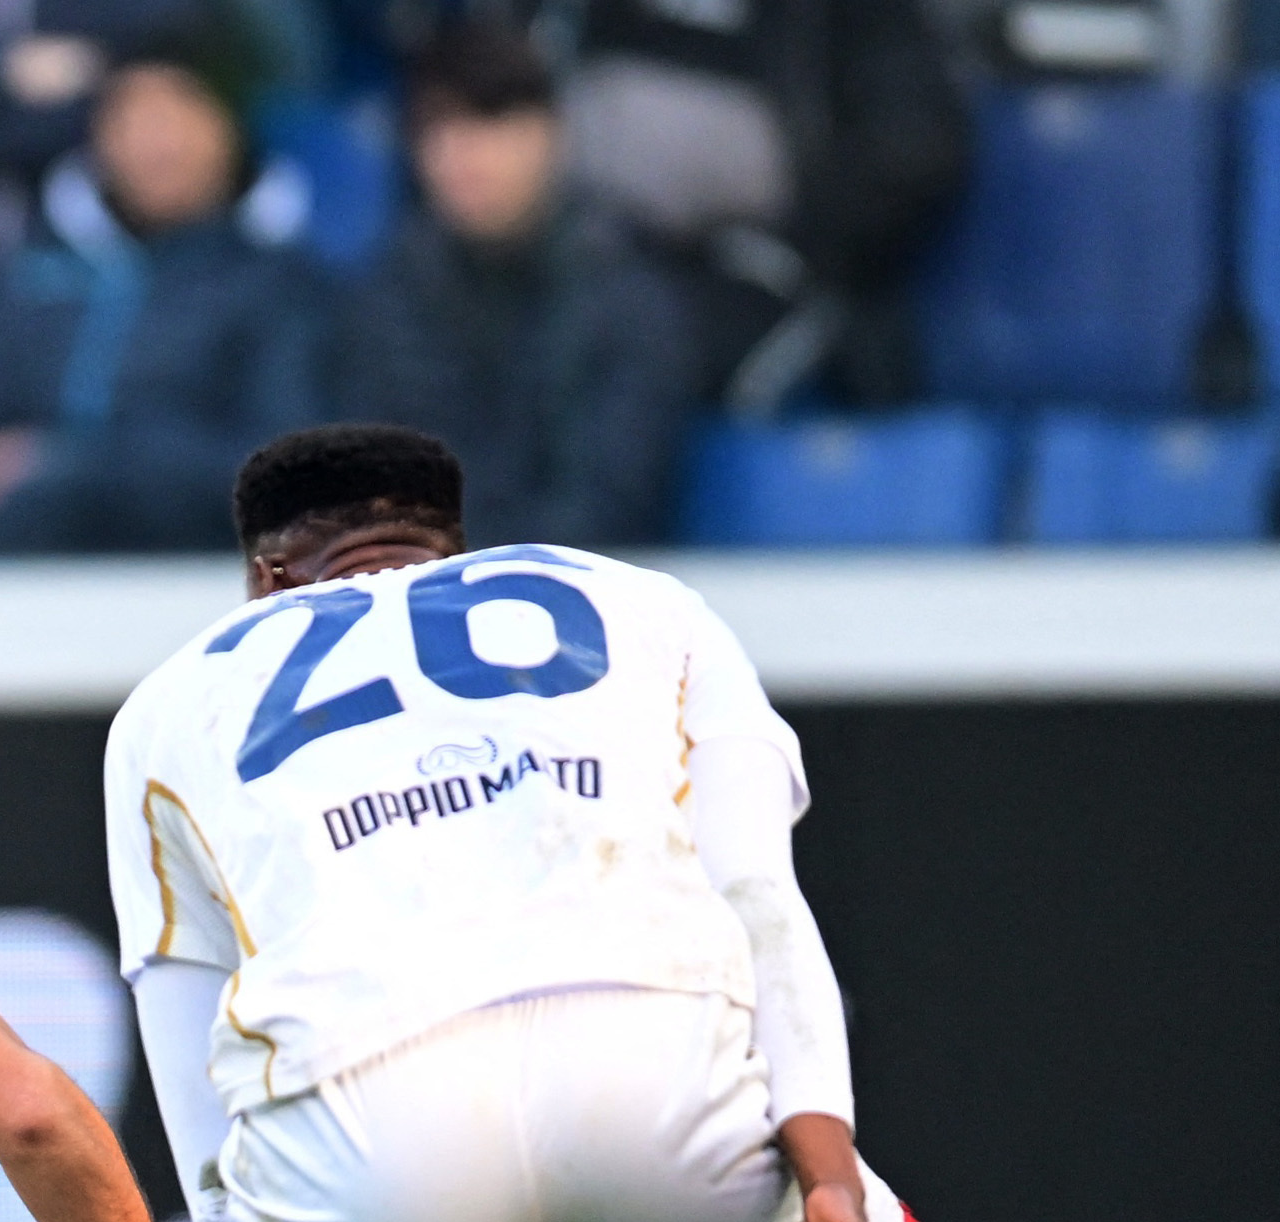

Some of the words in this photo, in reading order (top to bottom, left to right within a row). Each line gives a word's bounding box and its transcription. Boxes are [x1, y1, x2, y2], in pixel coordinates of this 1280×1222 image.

[204, 543, 610, 785] 26
[323, 775, 475, 853] DOPPIO
[478, 747, 602, 803] MATO
